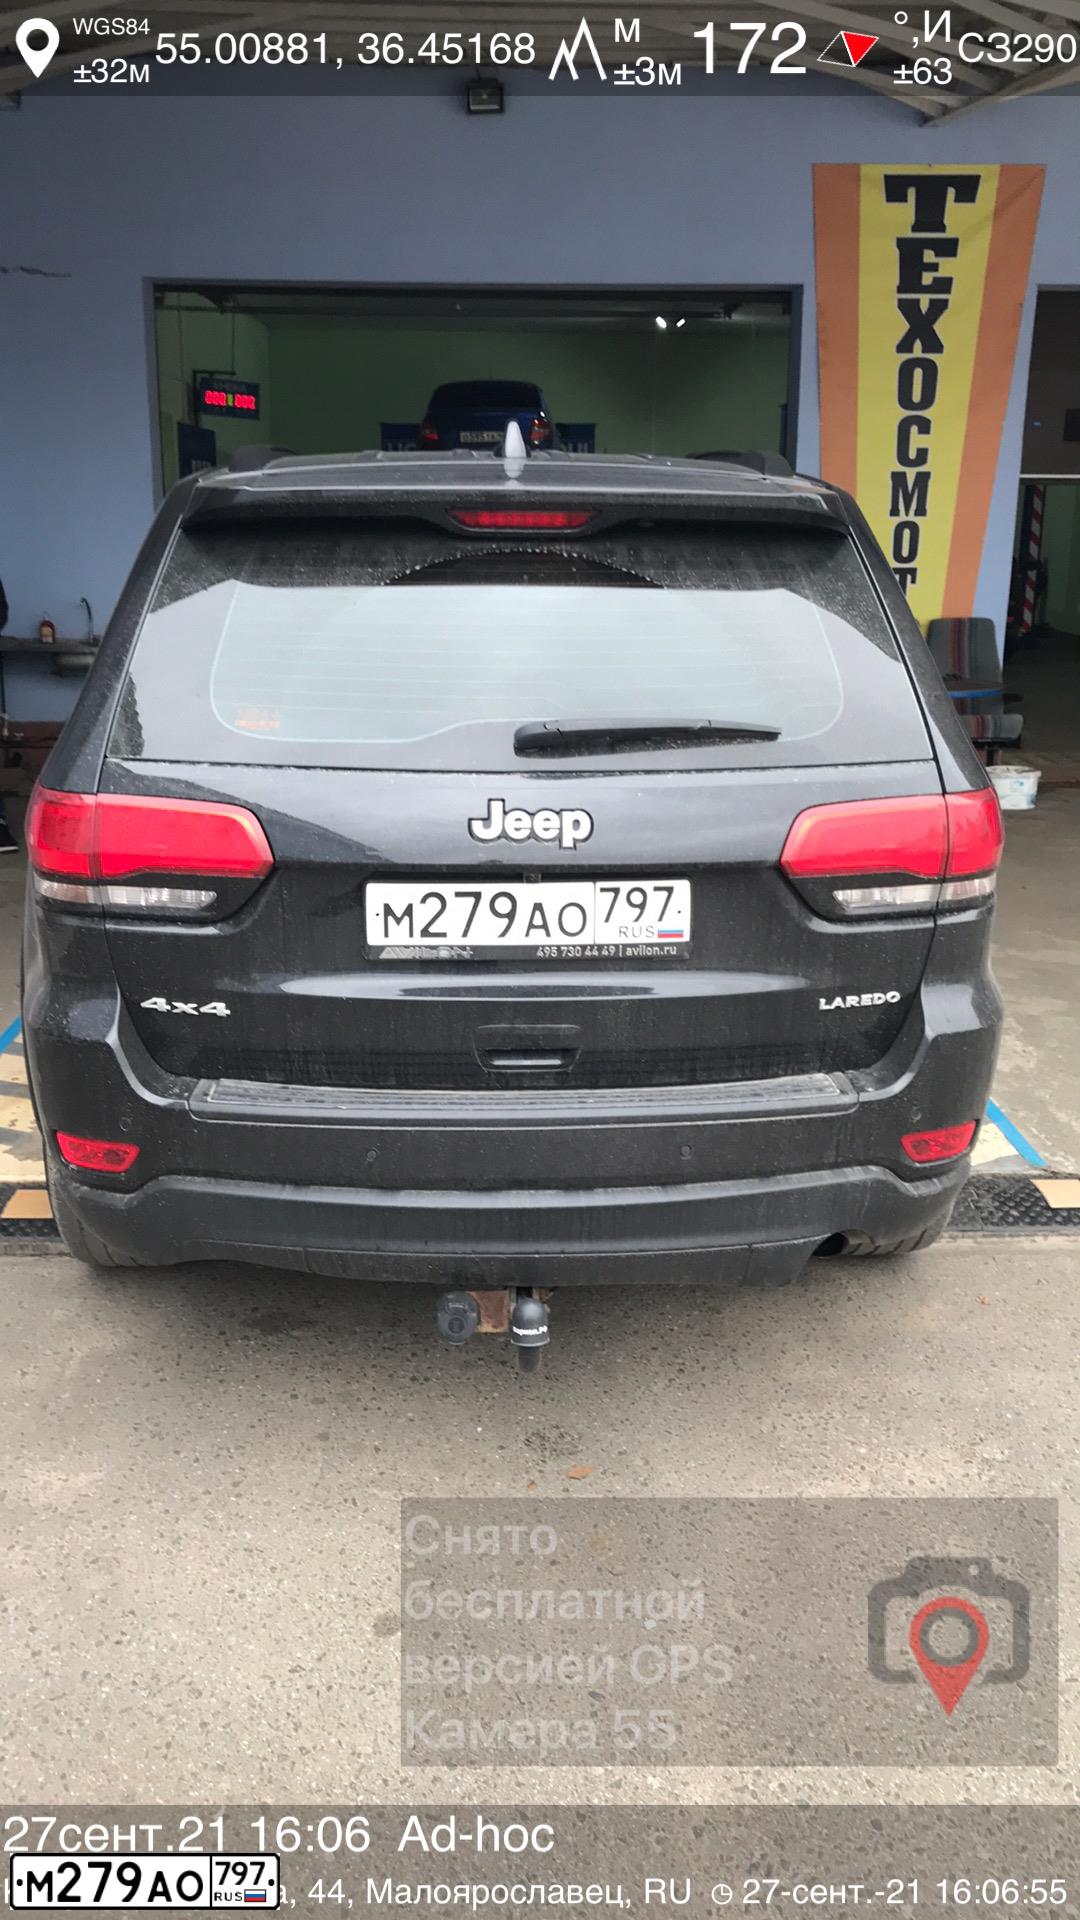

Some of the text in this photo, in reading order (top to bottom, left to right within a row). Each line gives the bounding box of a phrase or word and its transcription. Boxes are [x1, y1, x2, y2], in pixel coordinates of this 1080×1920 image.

[468, 798, 594, 849] Jeep
[600, 887, 673, 922] 797
[618, 925, 655, 938] RUS
[536, 946, 558, 958] 495
[561, 945, 582, 957] 730
[585, 945, 598, 957] 44
[602, 944, 615, 956] 49
[626, 944, 677, 956] avilon.ru
[818, 990, 901, 1011] LAREDO
